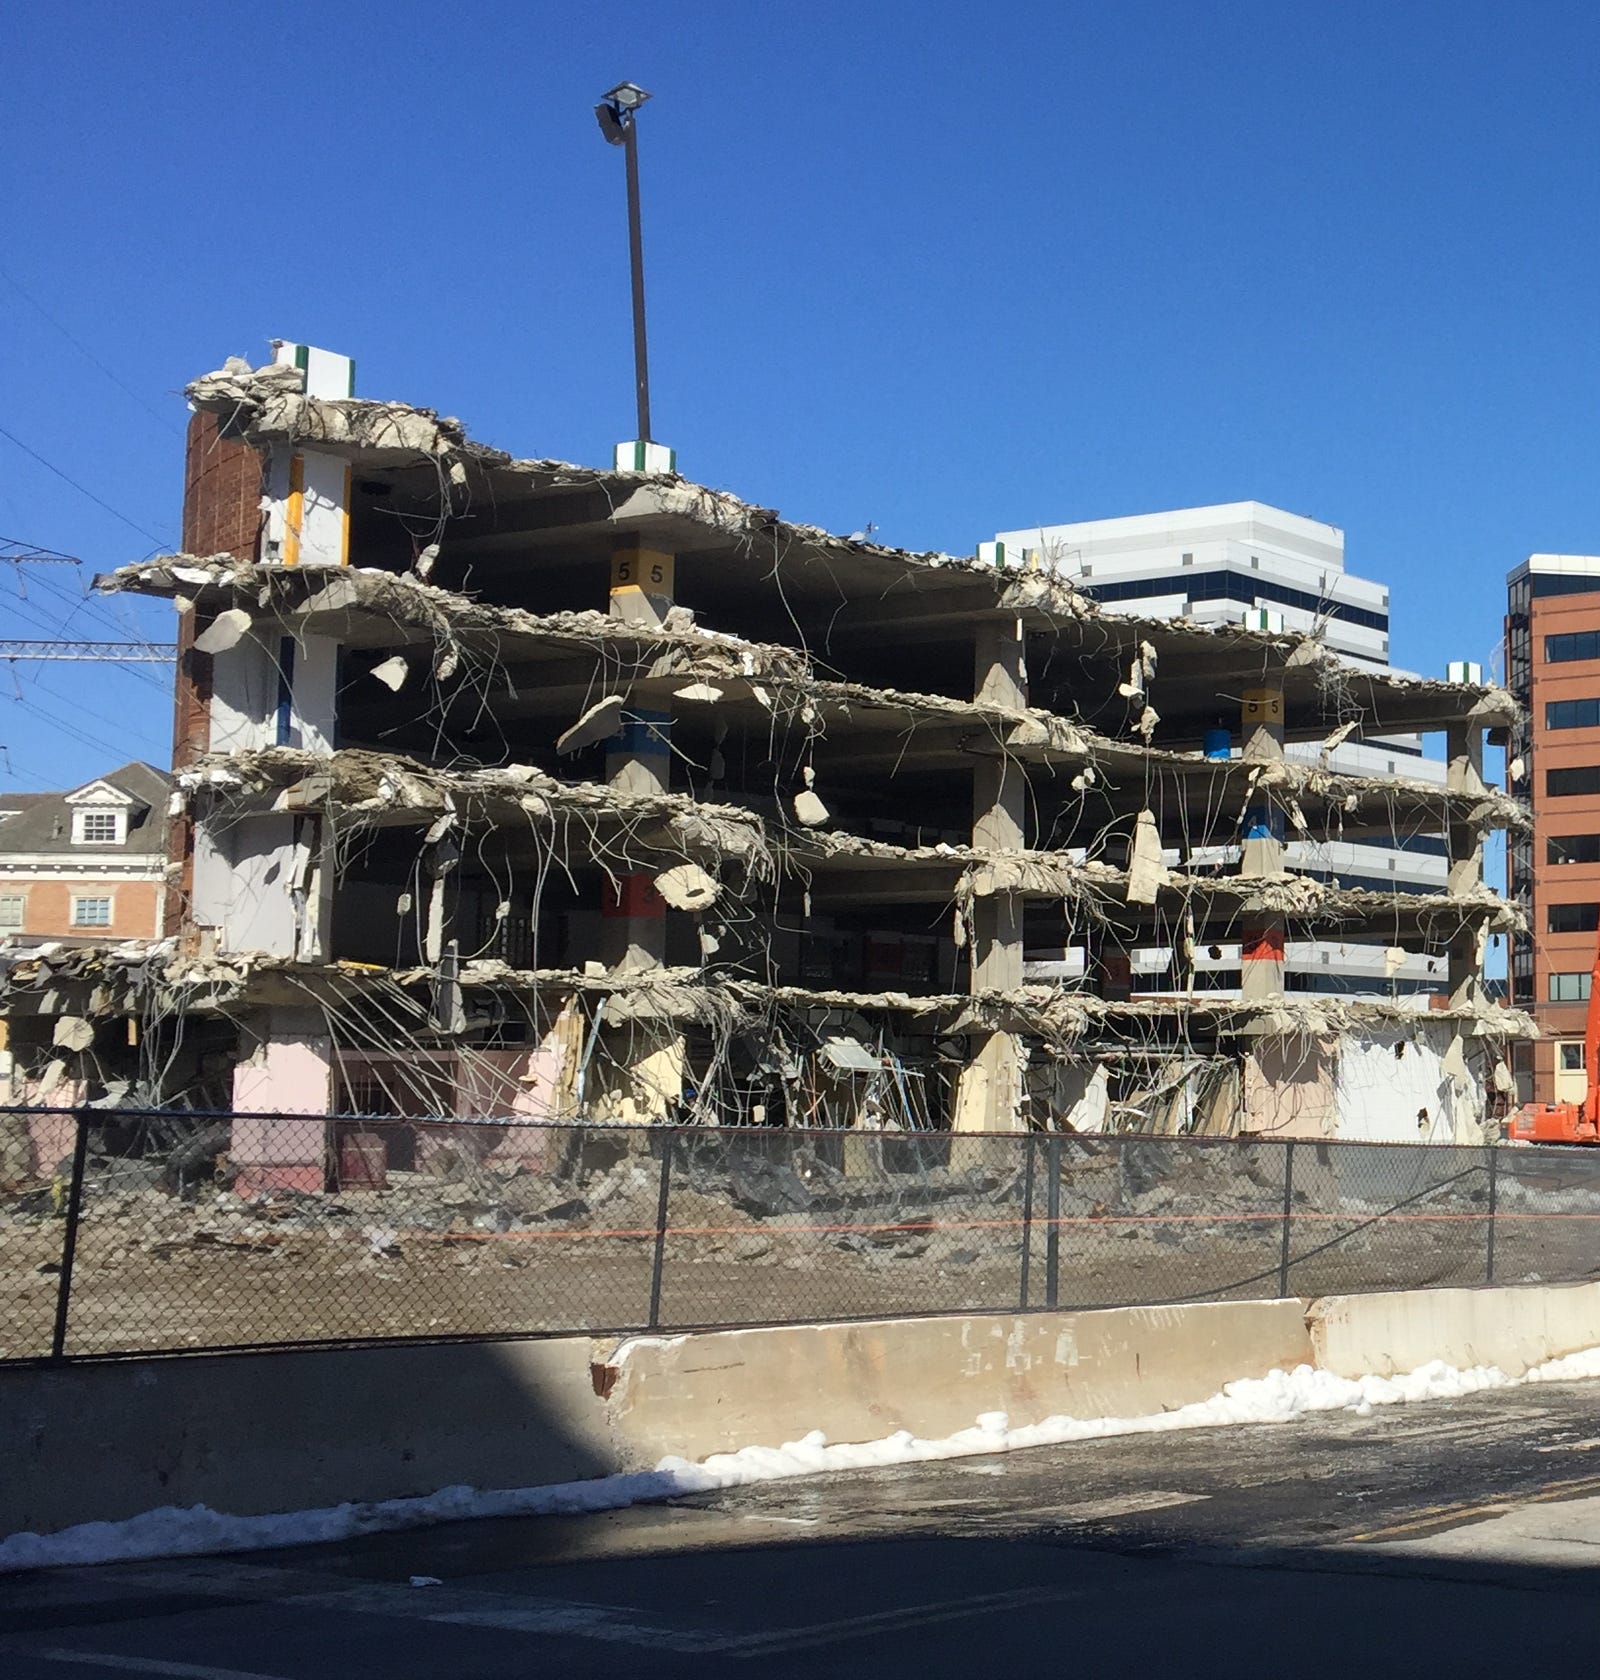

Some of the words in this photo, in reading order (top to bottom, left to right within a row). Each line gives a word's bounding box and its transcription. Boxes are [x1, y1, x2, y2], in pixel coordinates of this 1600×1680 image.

[618, 562, 630, 580] 5
[651, 564, 663, 583] 5
[1271, 700, 1279, 714] 5
